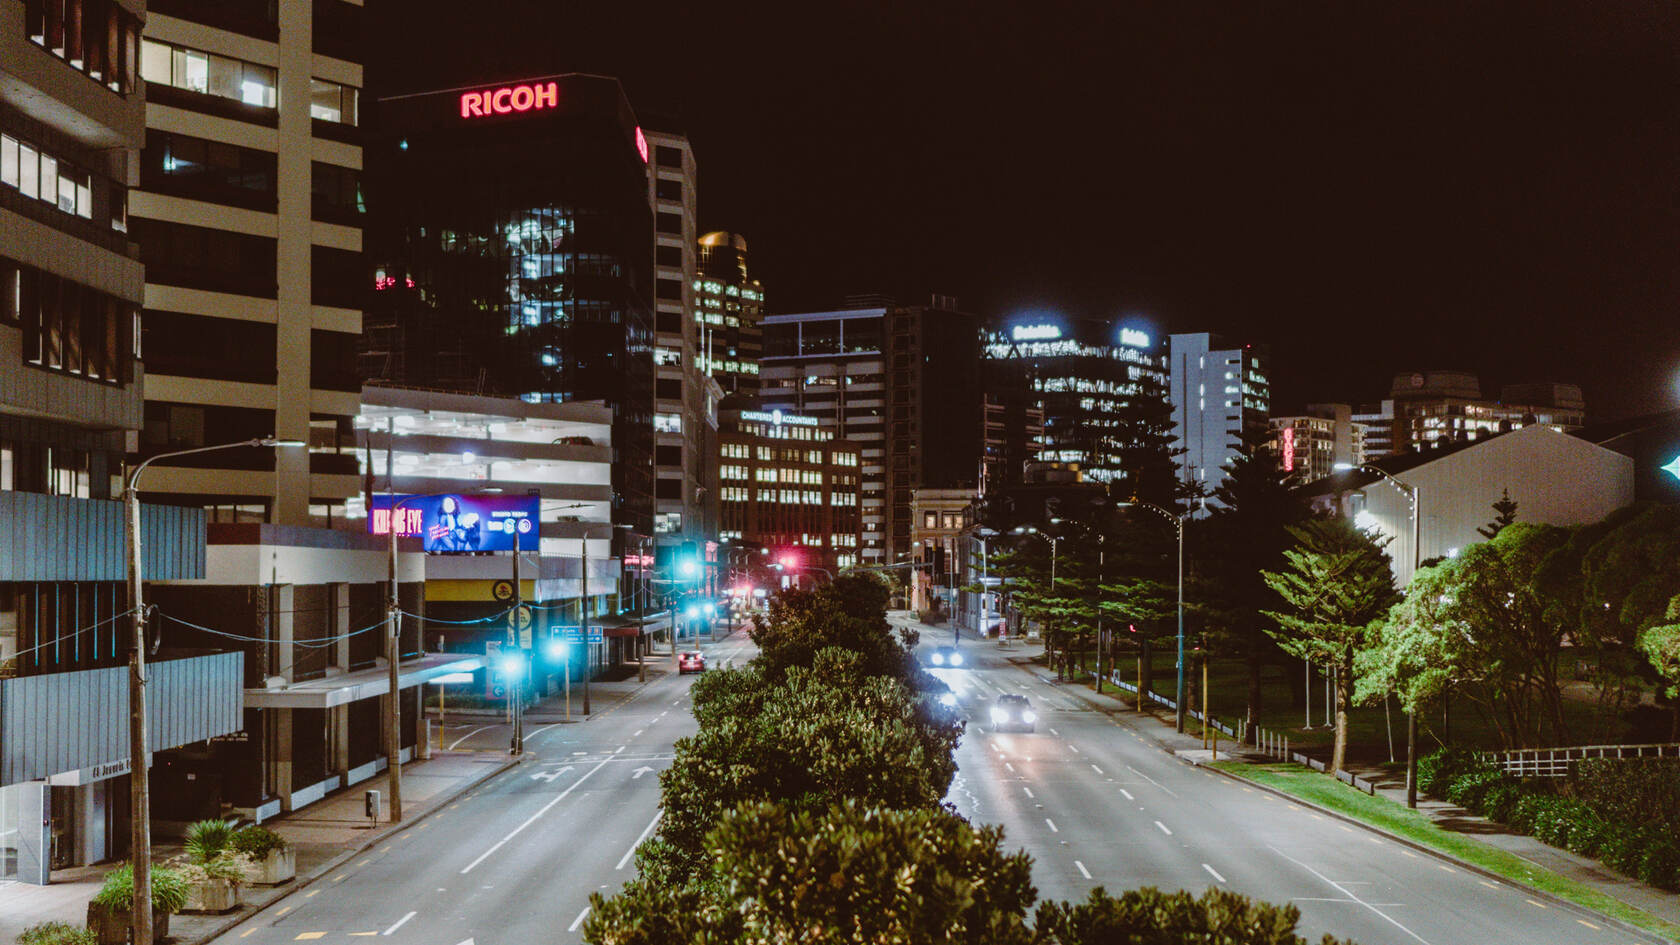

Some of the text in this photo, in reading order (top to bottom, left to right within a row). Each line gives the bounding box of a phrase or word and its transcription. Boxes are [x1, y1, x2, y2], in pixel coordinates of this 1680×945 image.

[460, 82, 558, 119] RICOH
[741, 410, 818, 426] CHARTERED ACCOUNTANTS
[407, 508, 423, 534] EVE
